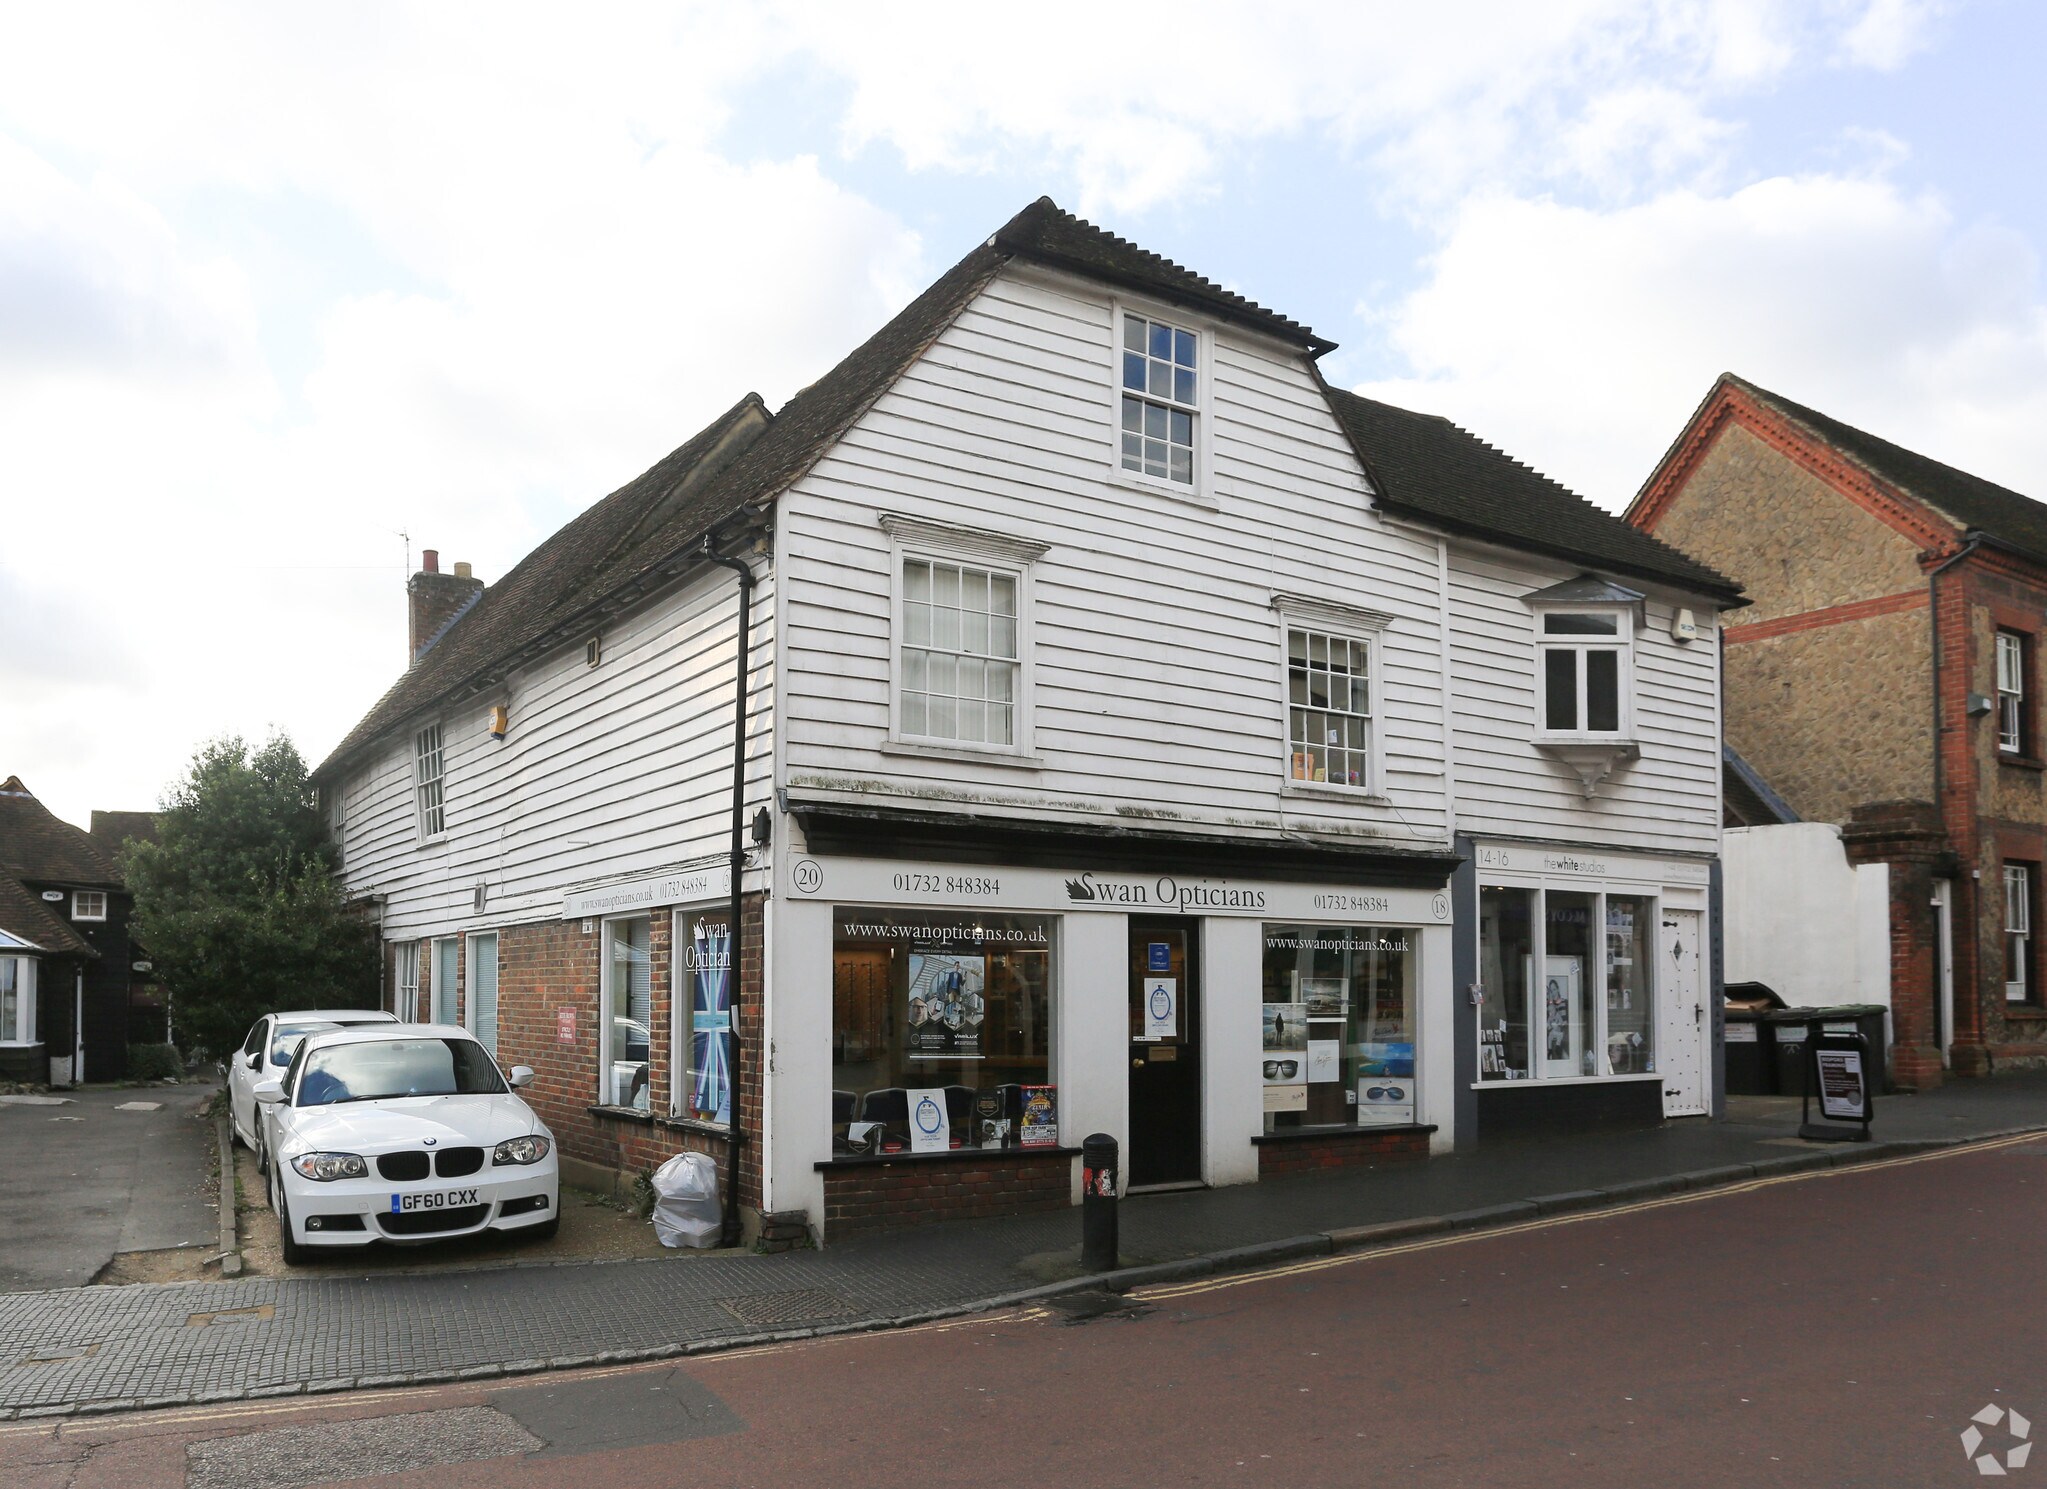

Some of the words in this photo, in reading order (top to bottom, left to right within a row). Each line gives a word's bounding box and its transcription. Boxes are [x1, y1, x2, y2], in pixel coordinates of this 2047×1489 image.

[1479, 849, 1509, 866] 14-16
[798, 867, 819, 886] 20
[893, 873, 940, 893] 01732
[946, 876, 1000, 896] 848384
[581, 885, 654, 911] www.swanopticians.co.uk
[659, 880, 680, 899] 01732
[681, 876, 708, 895] 848384
[1064, 871, 1147, 904] Swan
[1155, 876, 1266, 913] Opticians
[1313, 894, 1347, 911] 01732
[1350, 896, 1389, 912] 848384
[1434, 898, 1446, 914] 18
[692, 916, 727, 940] Swan
[844, 922, 1048, 944] www.swanopticians.co.uk
[1266, 935, 1409, 955] www.swanopticians.co.uk
[402, 1192, 444, 1210] GF60
[448, 1189, 478, 1206] CXX
